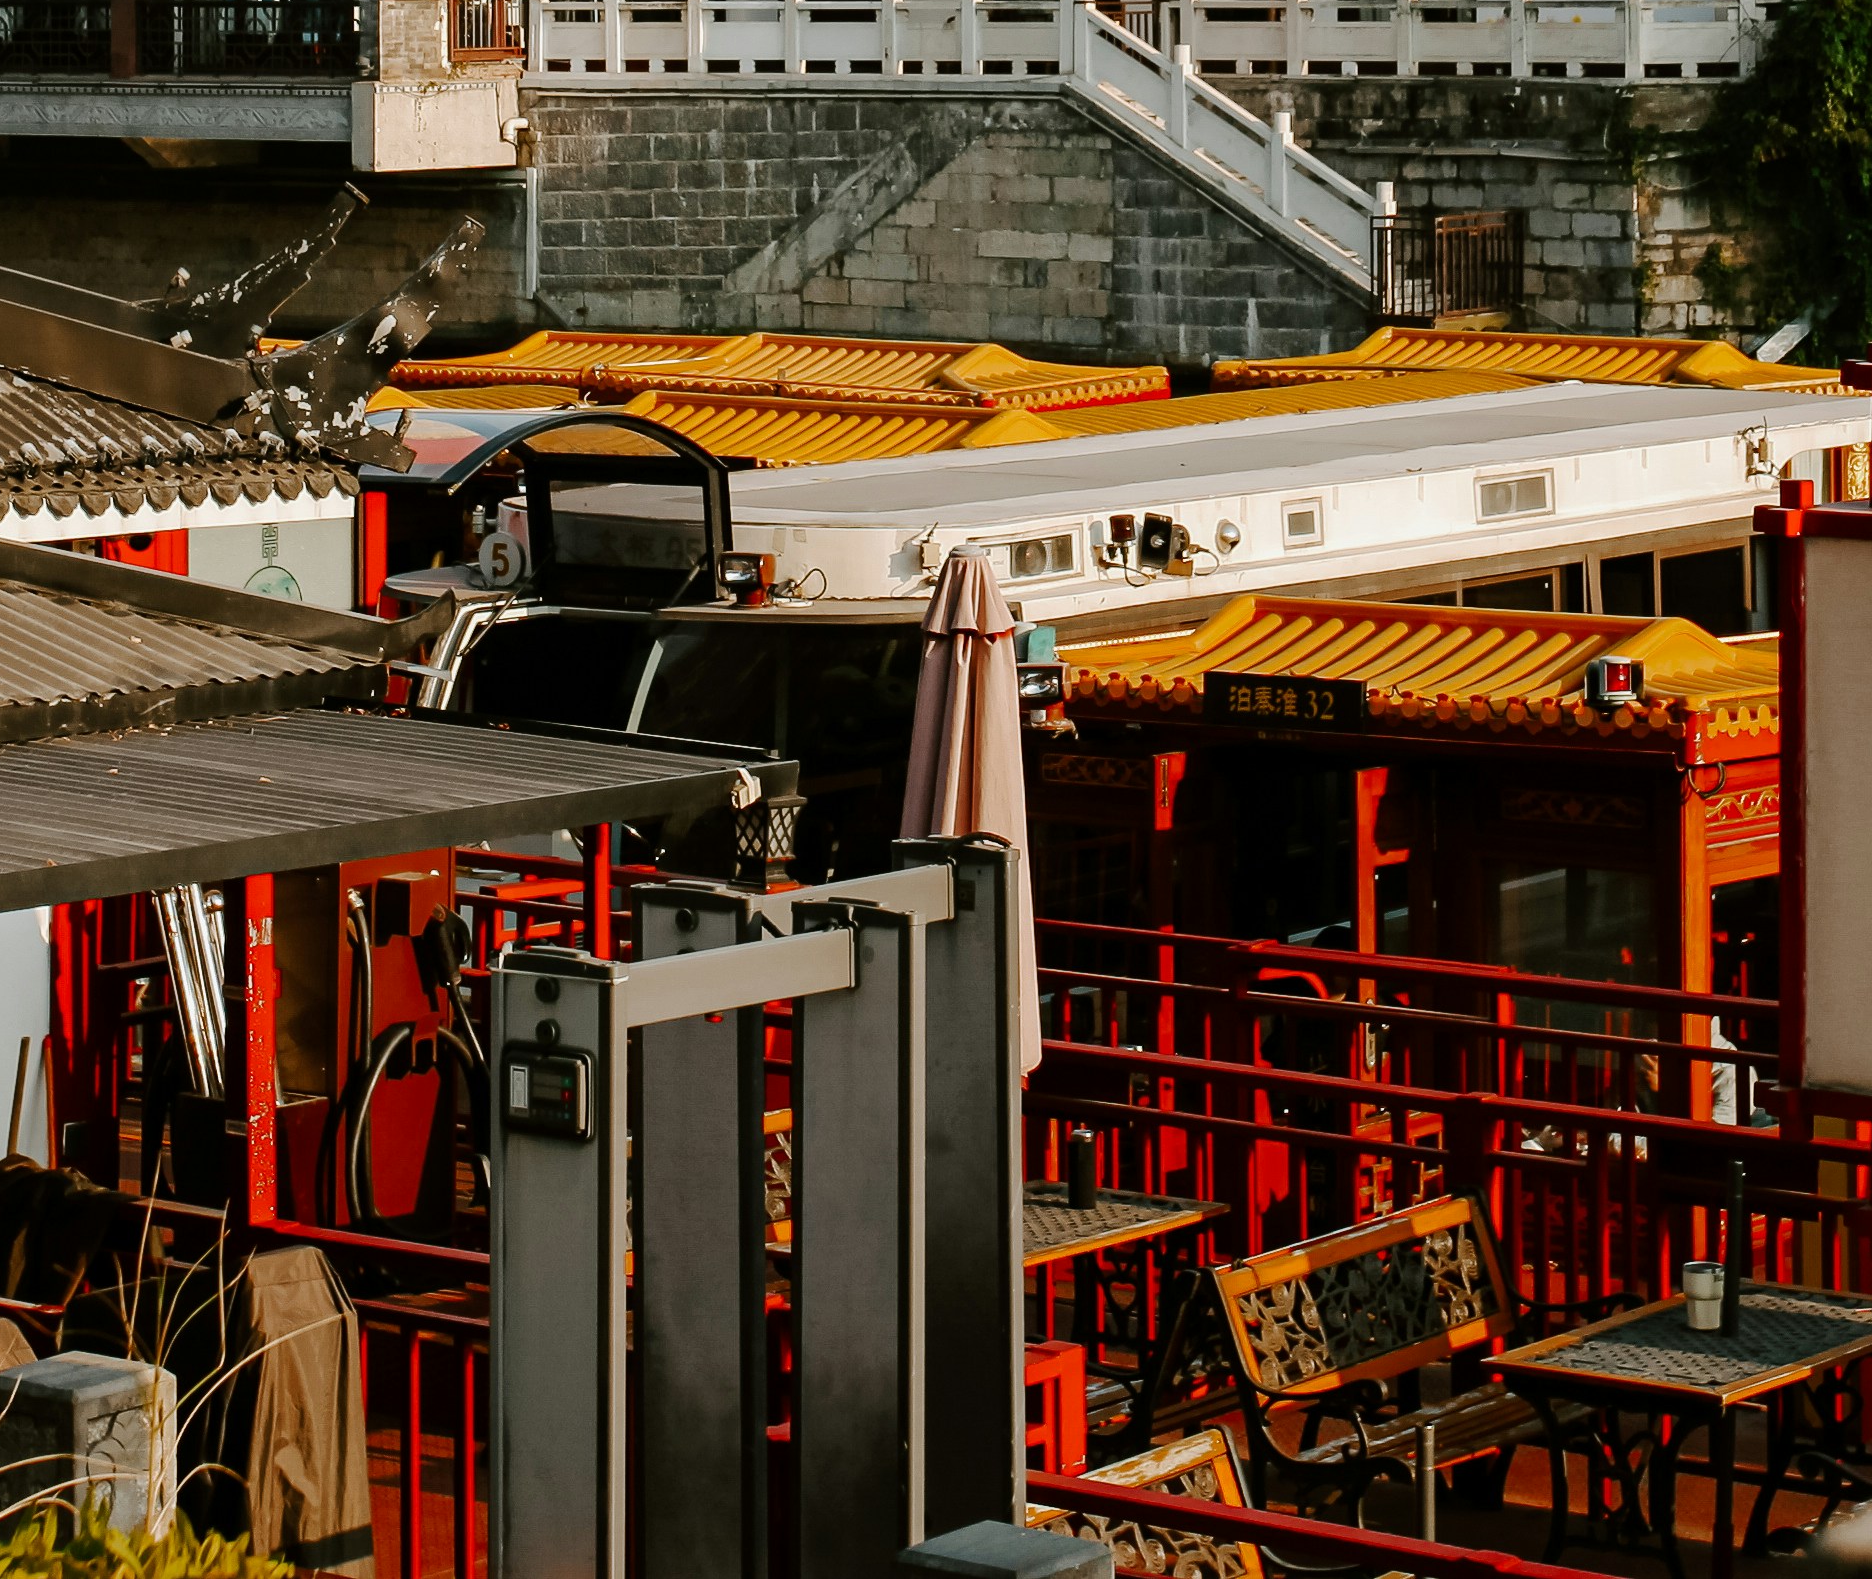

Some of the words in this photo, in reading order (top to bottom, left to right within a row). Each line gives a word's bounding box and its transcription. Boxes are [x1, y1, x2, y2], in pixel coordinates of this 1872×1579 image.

[491, 542, 510, 577] 5
[1229, 684, 1298, 717] 泊秦淮
[1304, 689, 1335, 720] 32
